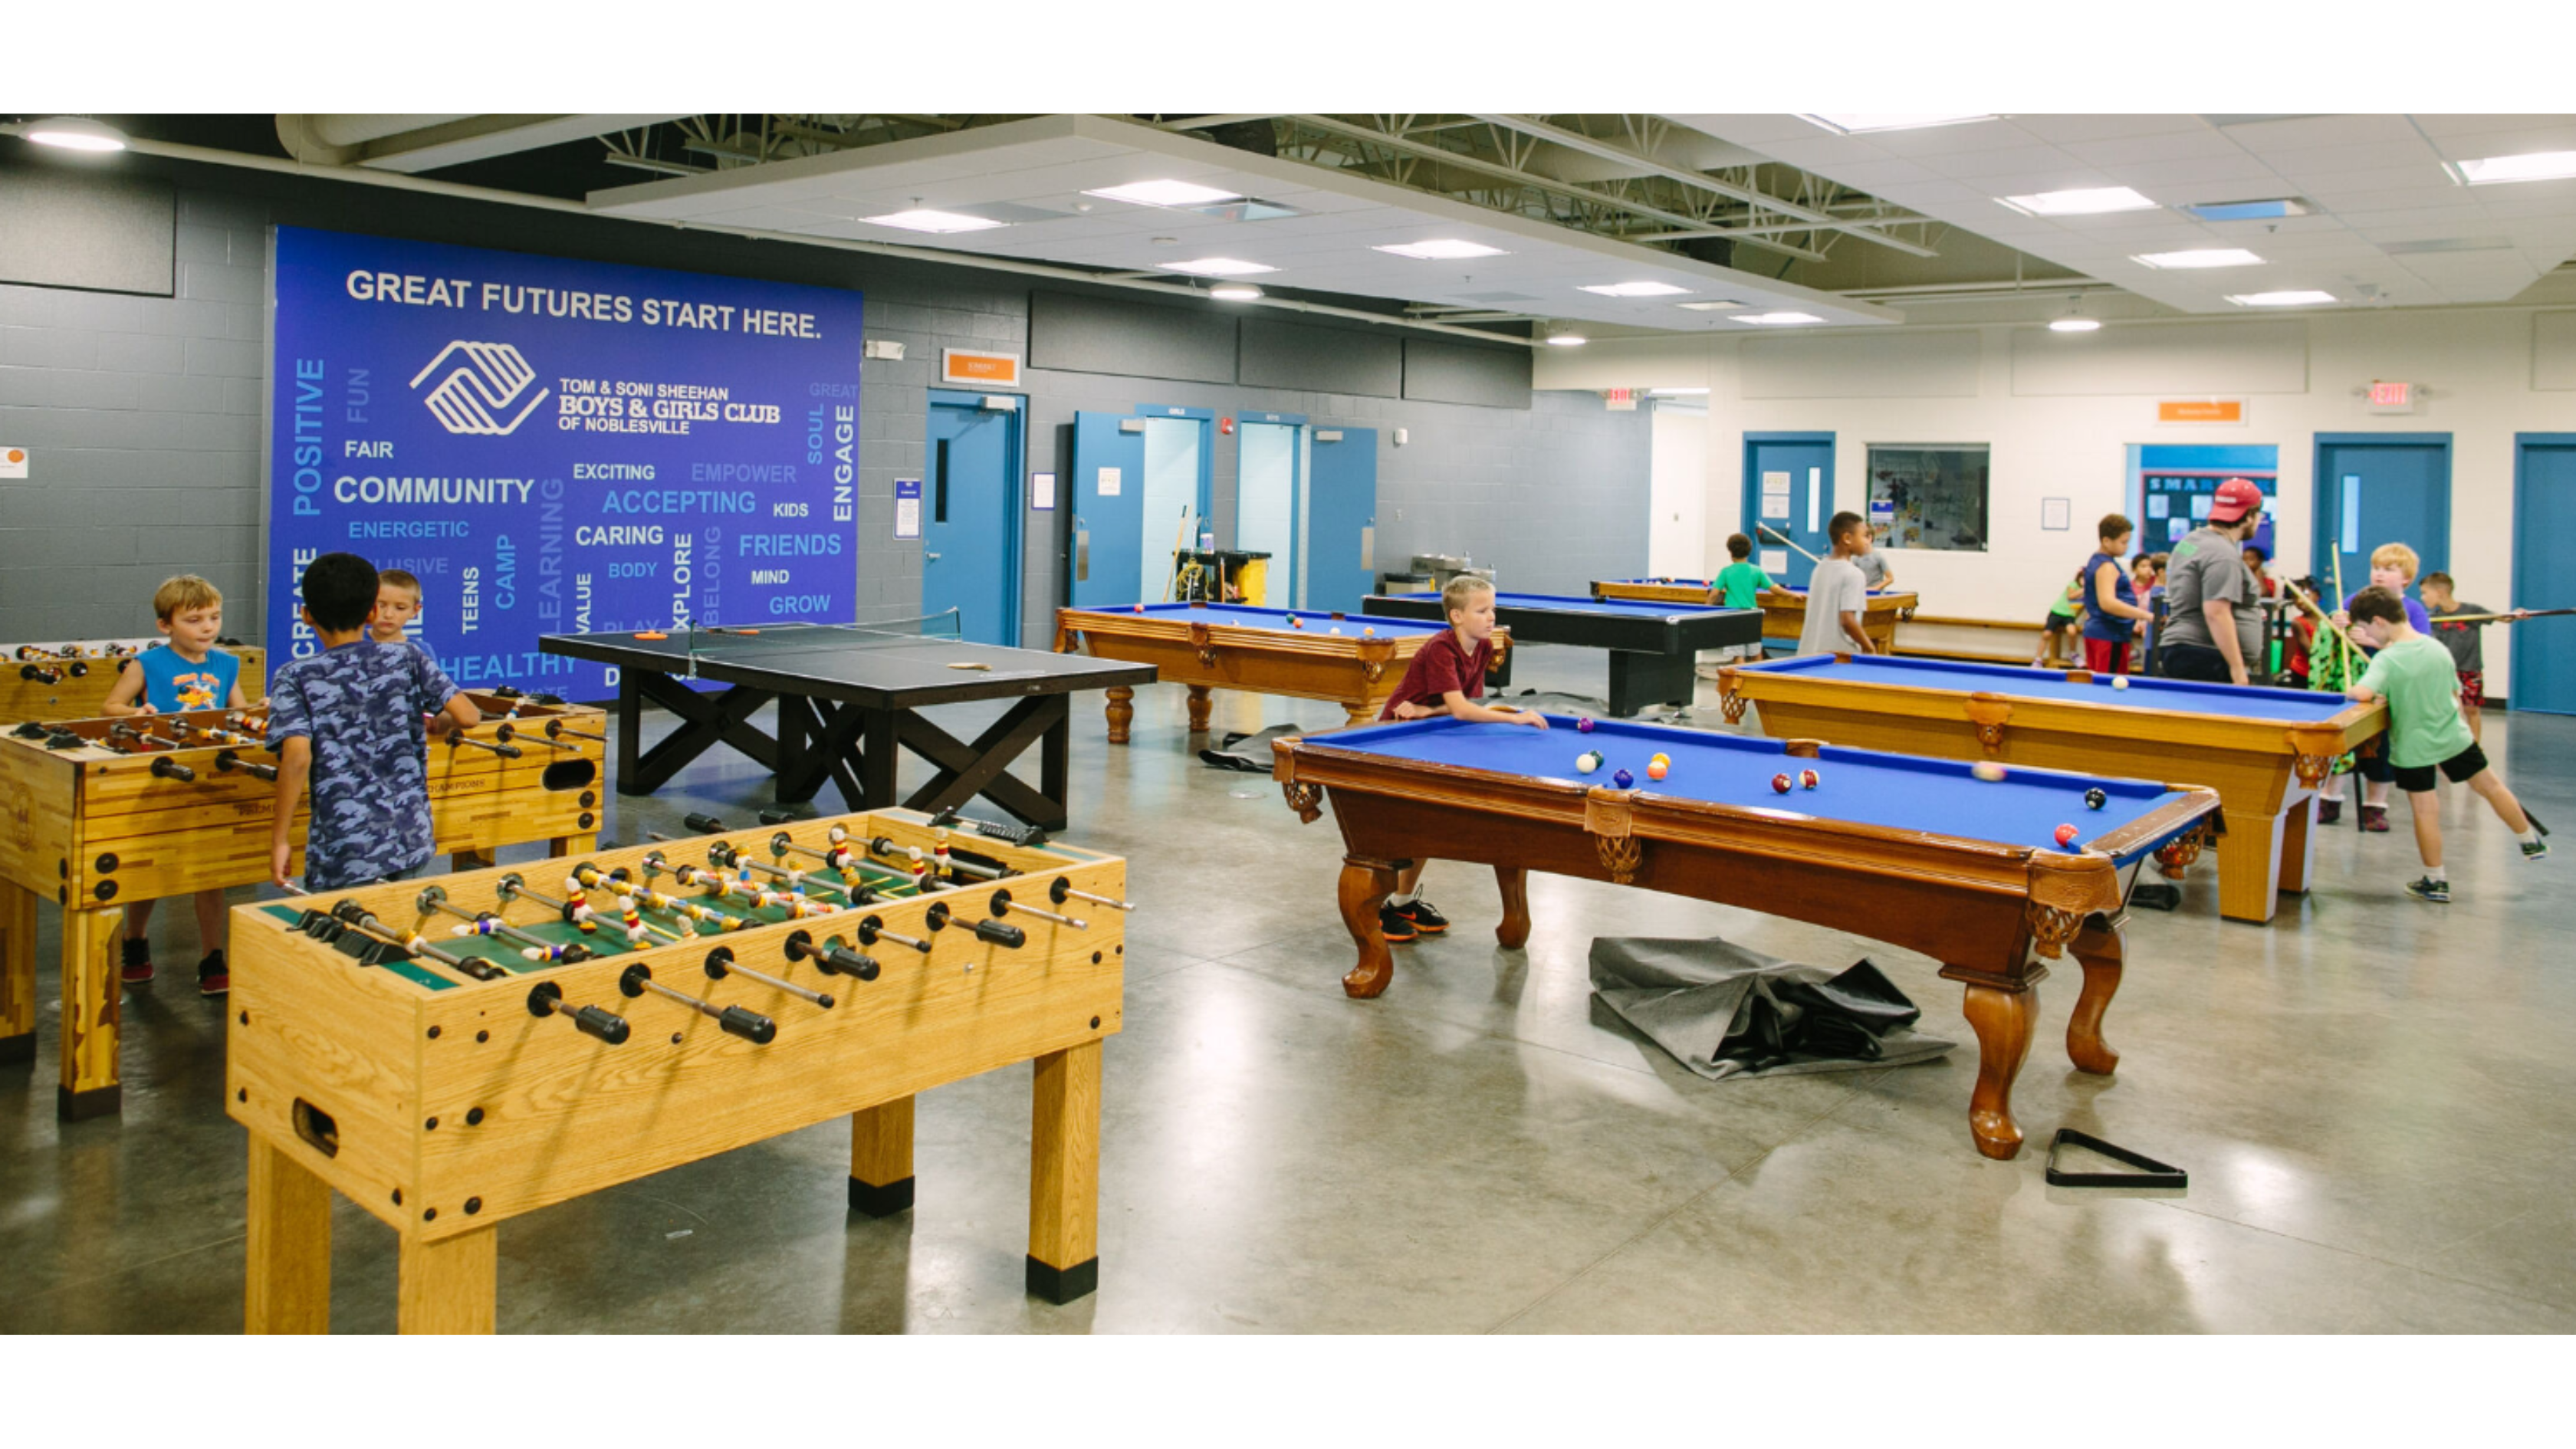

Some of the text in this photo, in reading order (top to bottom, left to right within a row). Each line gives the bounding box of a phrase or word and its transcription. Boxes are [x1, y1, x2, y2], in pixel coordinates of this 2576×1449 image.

[346, 269, 821, 340] GREAT FUTURES START HERE.
[347, 368, 370, 423] FUN
[560, 378, 728, 401] TOM & SONI SHEEHAN
[810, 383, 858, 399] GREAT
[2374, 383, 2408, 405] EXIT
[559, 395, 780, 424] BOYS & GIRLS CLUB
[293, 358, 324, 516] POSITIVE
[558, 417, 690, 435] OF NOBLESVILLE
[808, 404, 823, 465] SOUL
[345, 440, 393, 458] FAIR
[573, 464, 656, 480] EXCITING
[692, 463, 797, 483] EMPOWER
[833, 406, 853, 521] ENGAGE
[334, 476, 534, 504] COMMUNITY
[2149, 477, 2225, 491] SMAR
[602, 490, 756, 514] ACCEPTING
[773, 503, 809, 518] KIDS
[349, 521, 469, 539] ENERGETIC
[576, 526, 664, 546] CARING
[739, 534, 842, 557] FRIENDS
[370, 557, 449, 574] LUSIVE
[495, 535, 516, 610] CAMP
[609, 562, 658, 578] BODY
[704, 526, 721, 625] BELONG
[673, 534, 692, 630] XPLORE
[751, 570, 790, 585] MIND
[462, 567, 479, 635] TEENS
[576, 573, 591, 636] VALUE
[770, 595, 831, 614] GROW
[440, 652, 575, 682] HEALTHY
